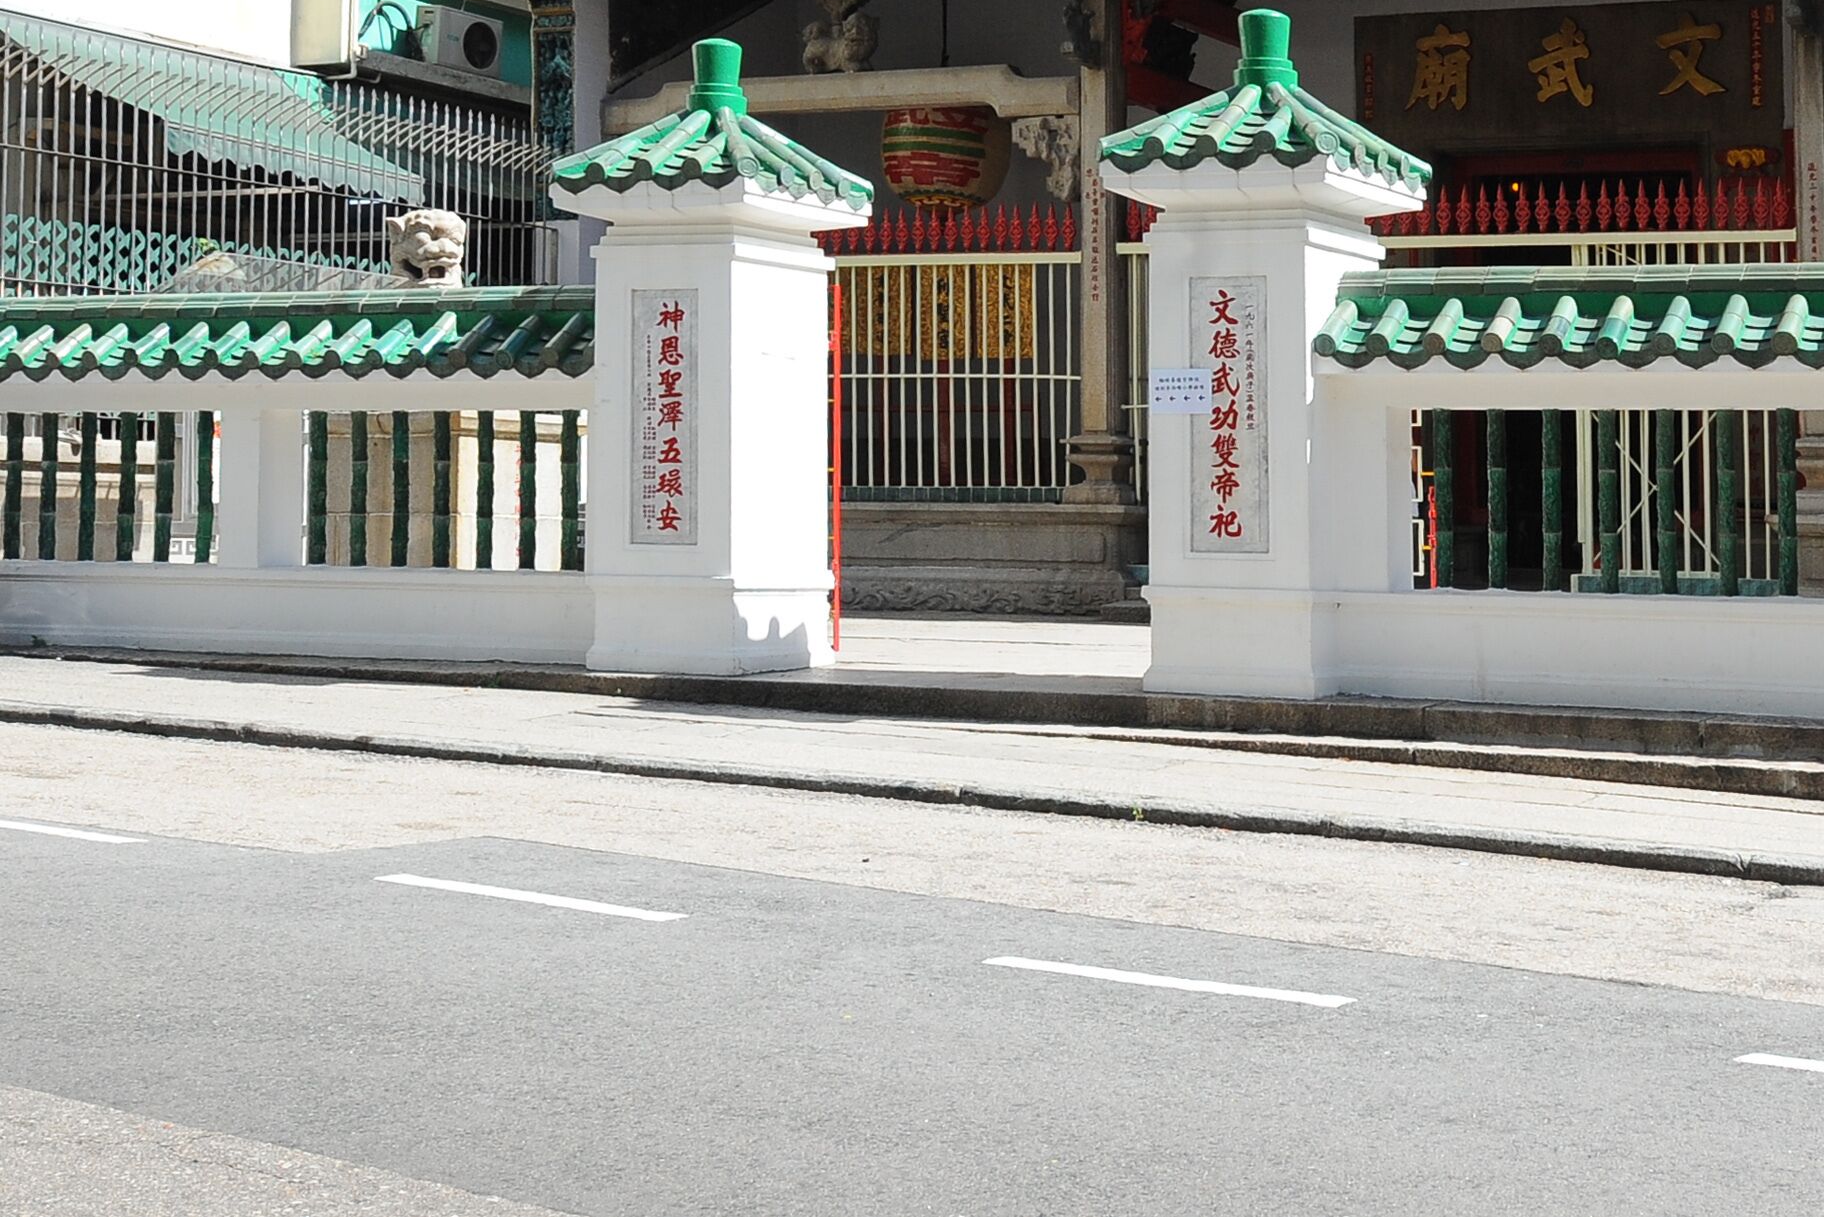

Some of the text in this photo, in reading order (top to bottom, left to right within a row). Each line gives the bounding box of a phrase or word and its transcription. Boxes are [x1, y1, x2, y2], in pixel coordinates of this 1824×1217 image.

[656, 300, 685, 531] 神恩聖澤五環安
[1208, 289, 1242, 538] 文德武功雙帝祀
